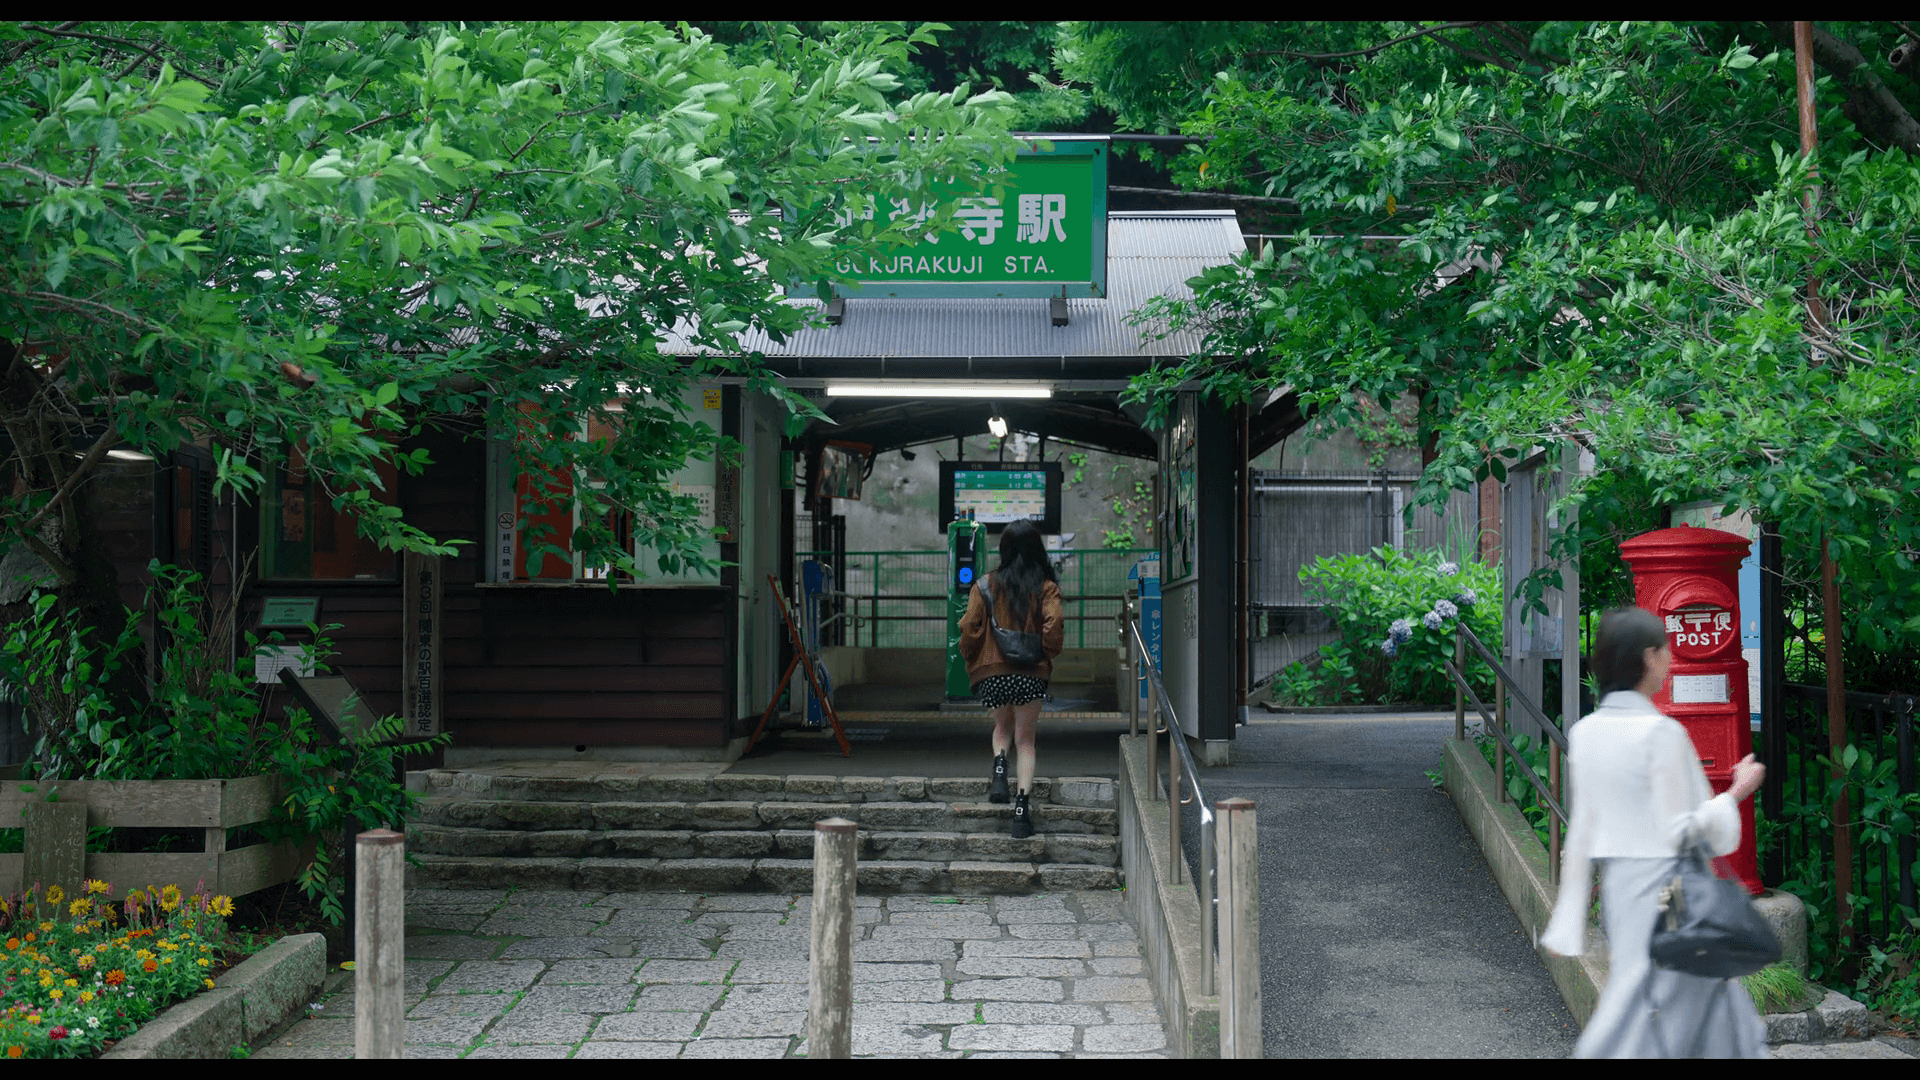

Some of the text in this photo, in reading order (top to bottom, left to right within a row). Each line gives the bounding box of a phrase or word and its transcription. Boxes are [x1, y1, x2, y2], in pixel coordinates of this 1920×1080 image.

[832, 193, 1067, 245] 寺駅
[1004, 255, 1055, 274] STA.
[1676, 632, 1722, 647] POST
